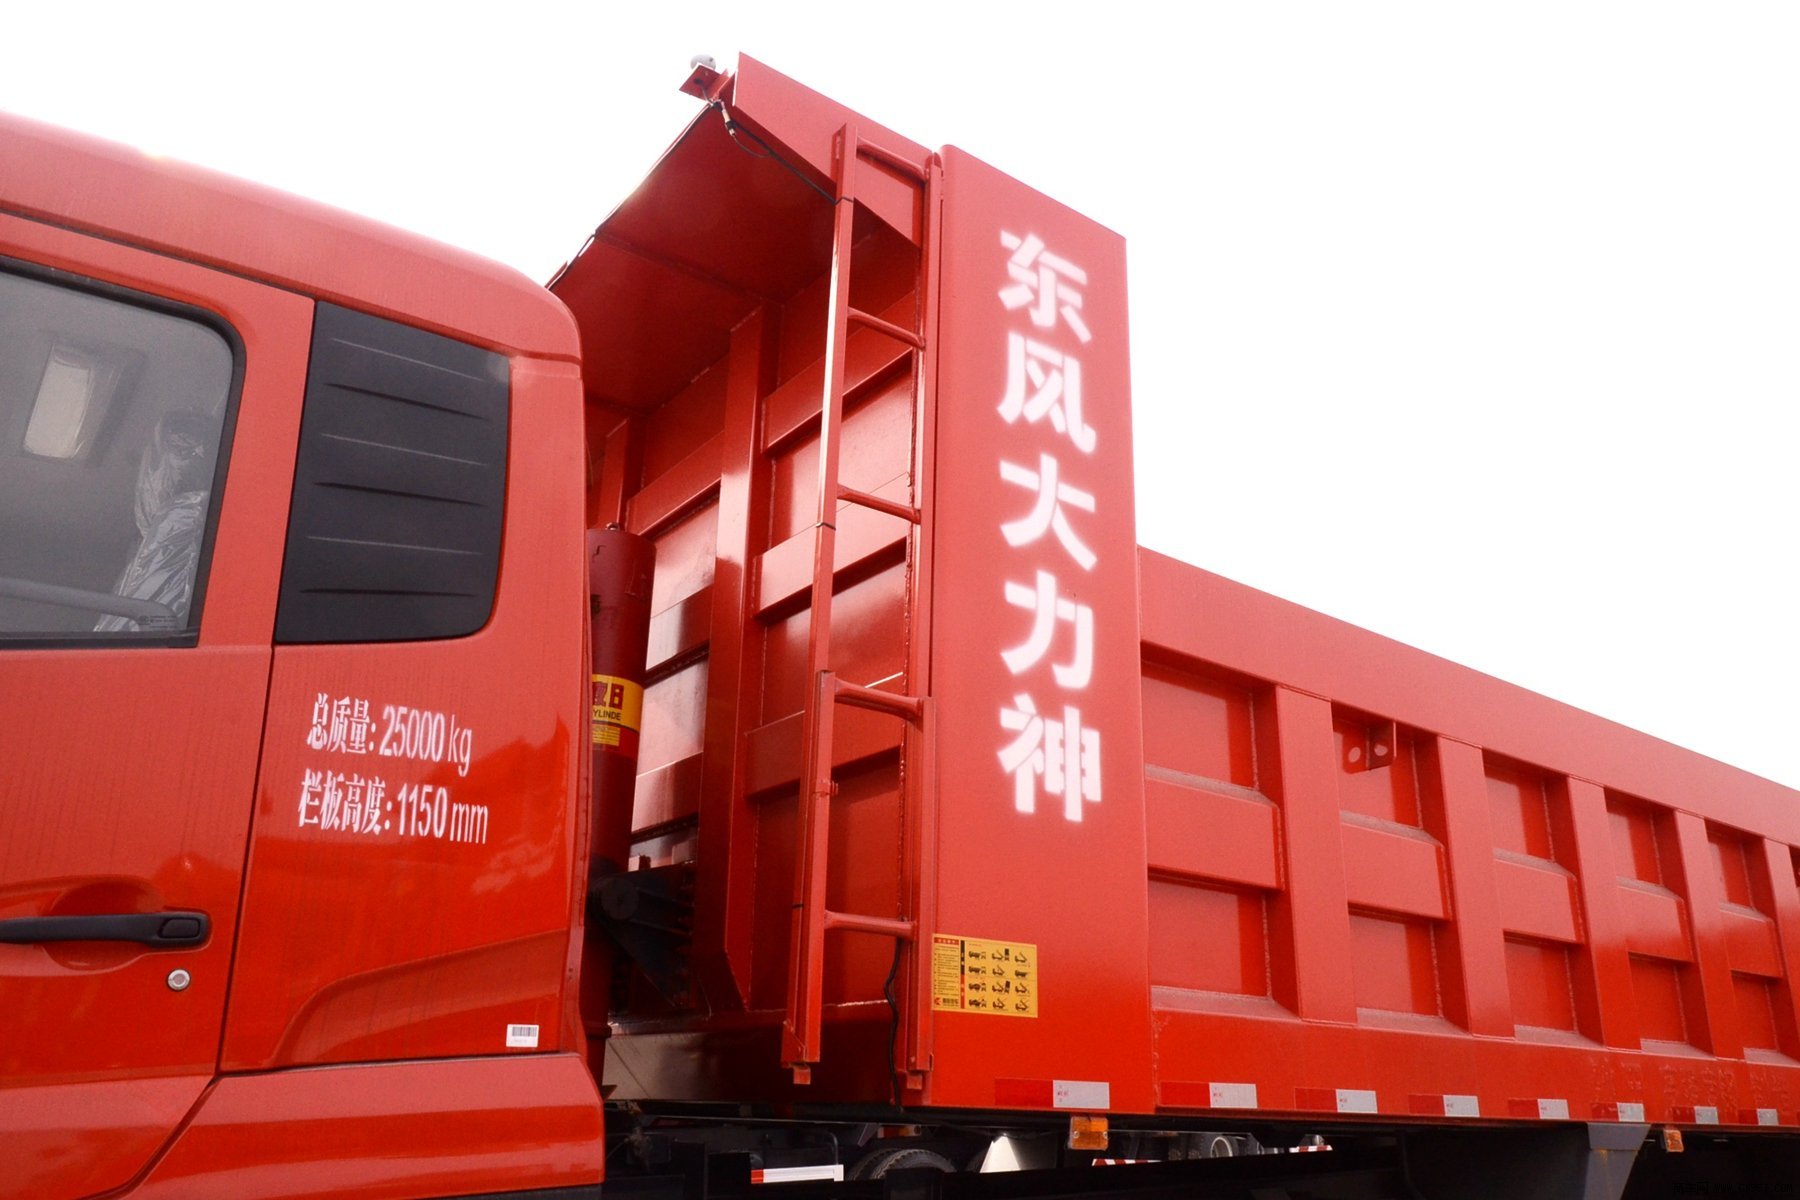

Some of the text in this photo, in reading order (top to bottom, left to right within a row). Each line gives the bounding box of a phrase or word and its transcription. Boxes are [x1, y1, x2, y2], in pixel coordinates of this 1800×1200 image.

[997, 230, 1102, 824] 东风大力神
[379, 705, 445, 762] 25000
[448, 714, 472, 777] kg
[592, 708, 622, 721] YLINDE
[398, 783, 448, 839] 1150
[449, 802, 488, 845] mm
